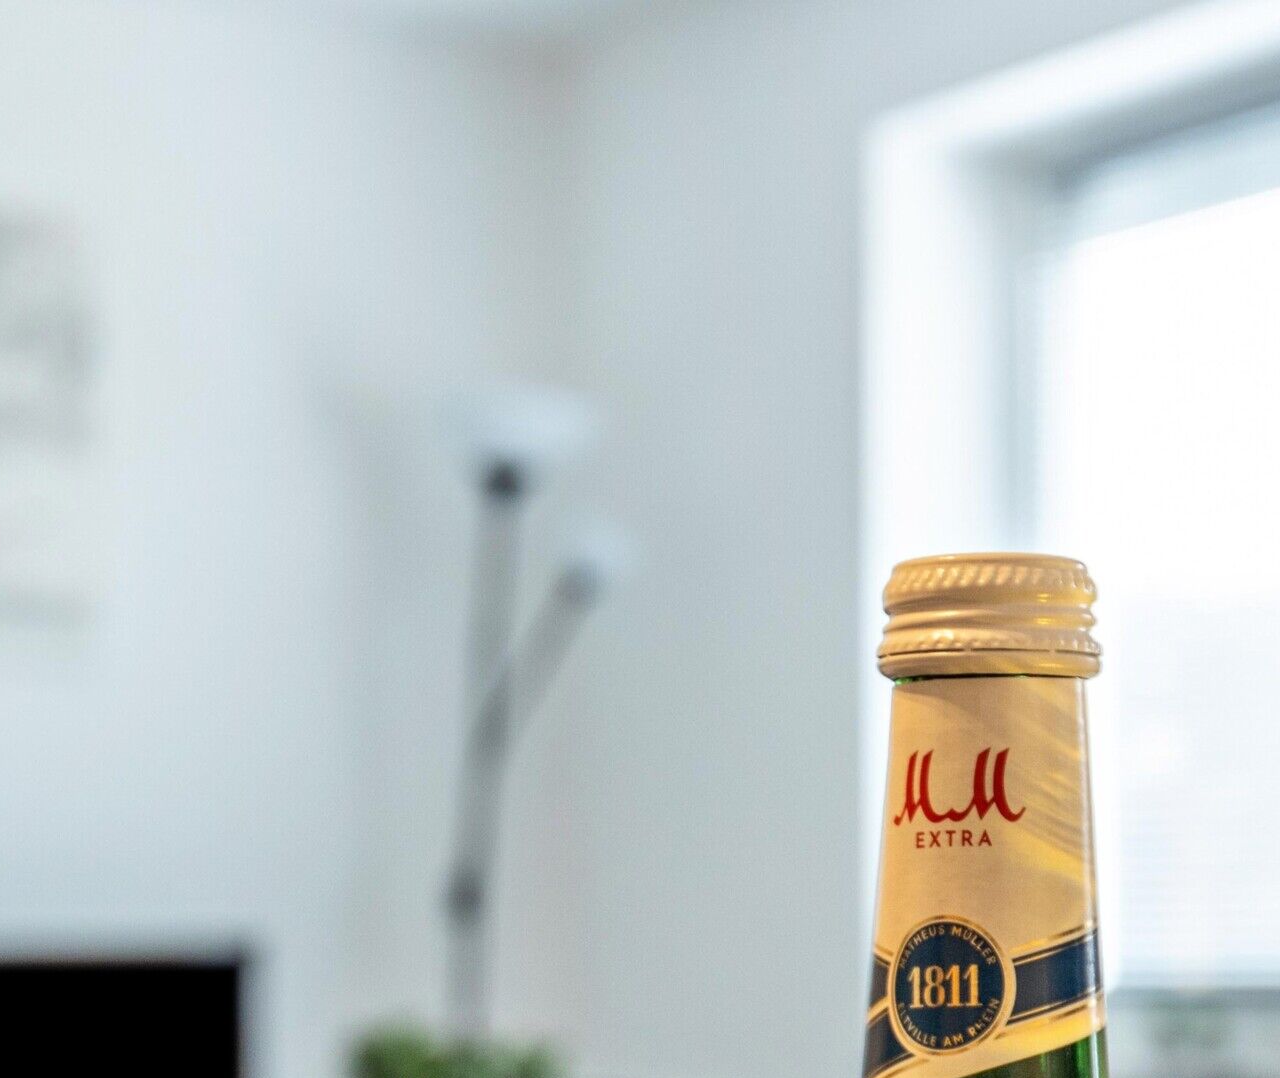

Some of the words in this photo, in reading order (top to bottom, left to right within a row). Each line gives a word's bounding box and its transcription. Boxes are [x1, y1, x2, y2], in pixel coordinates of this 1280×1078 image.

[915, 829, 992, 848] EXTRA
[907, 963, 983, 1009] 1811
[943, 1032, 965, 1048] AM
